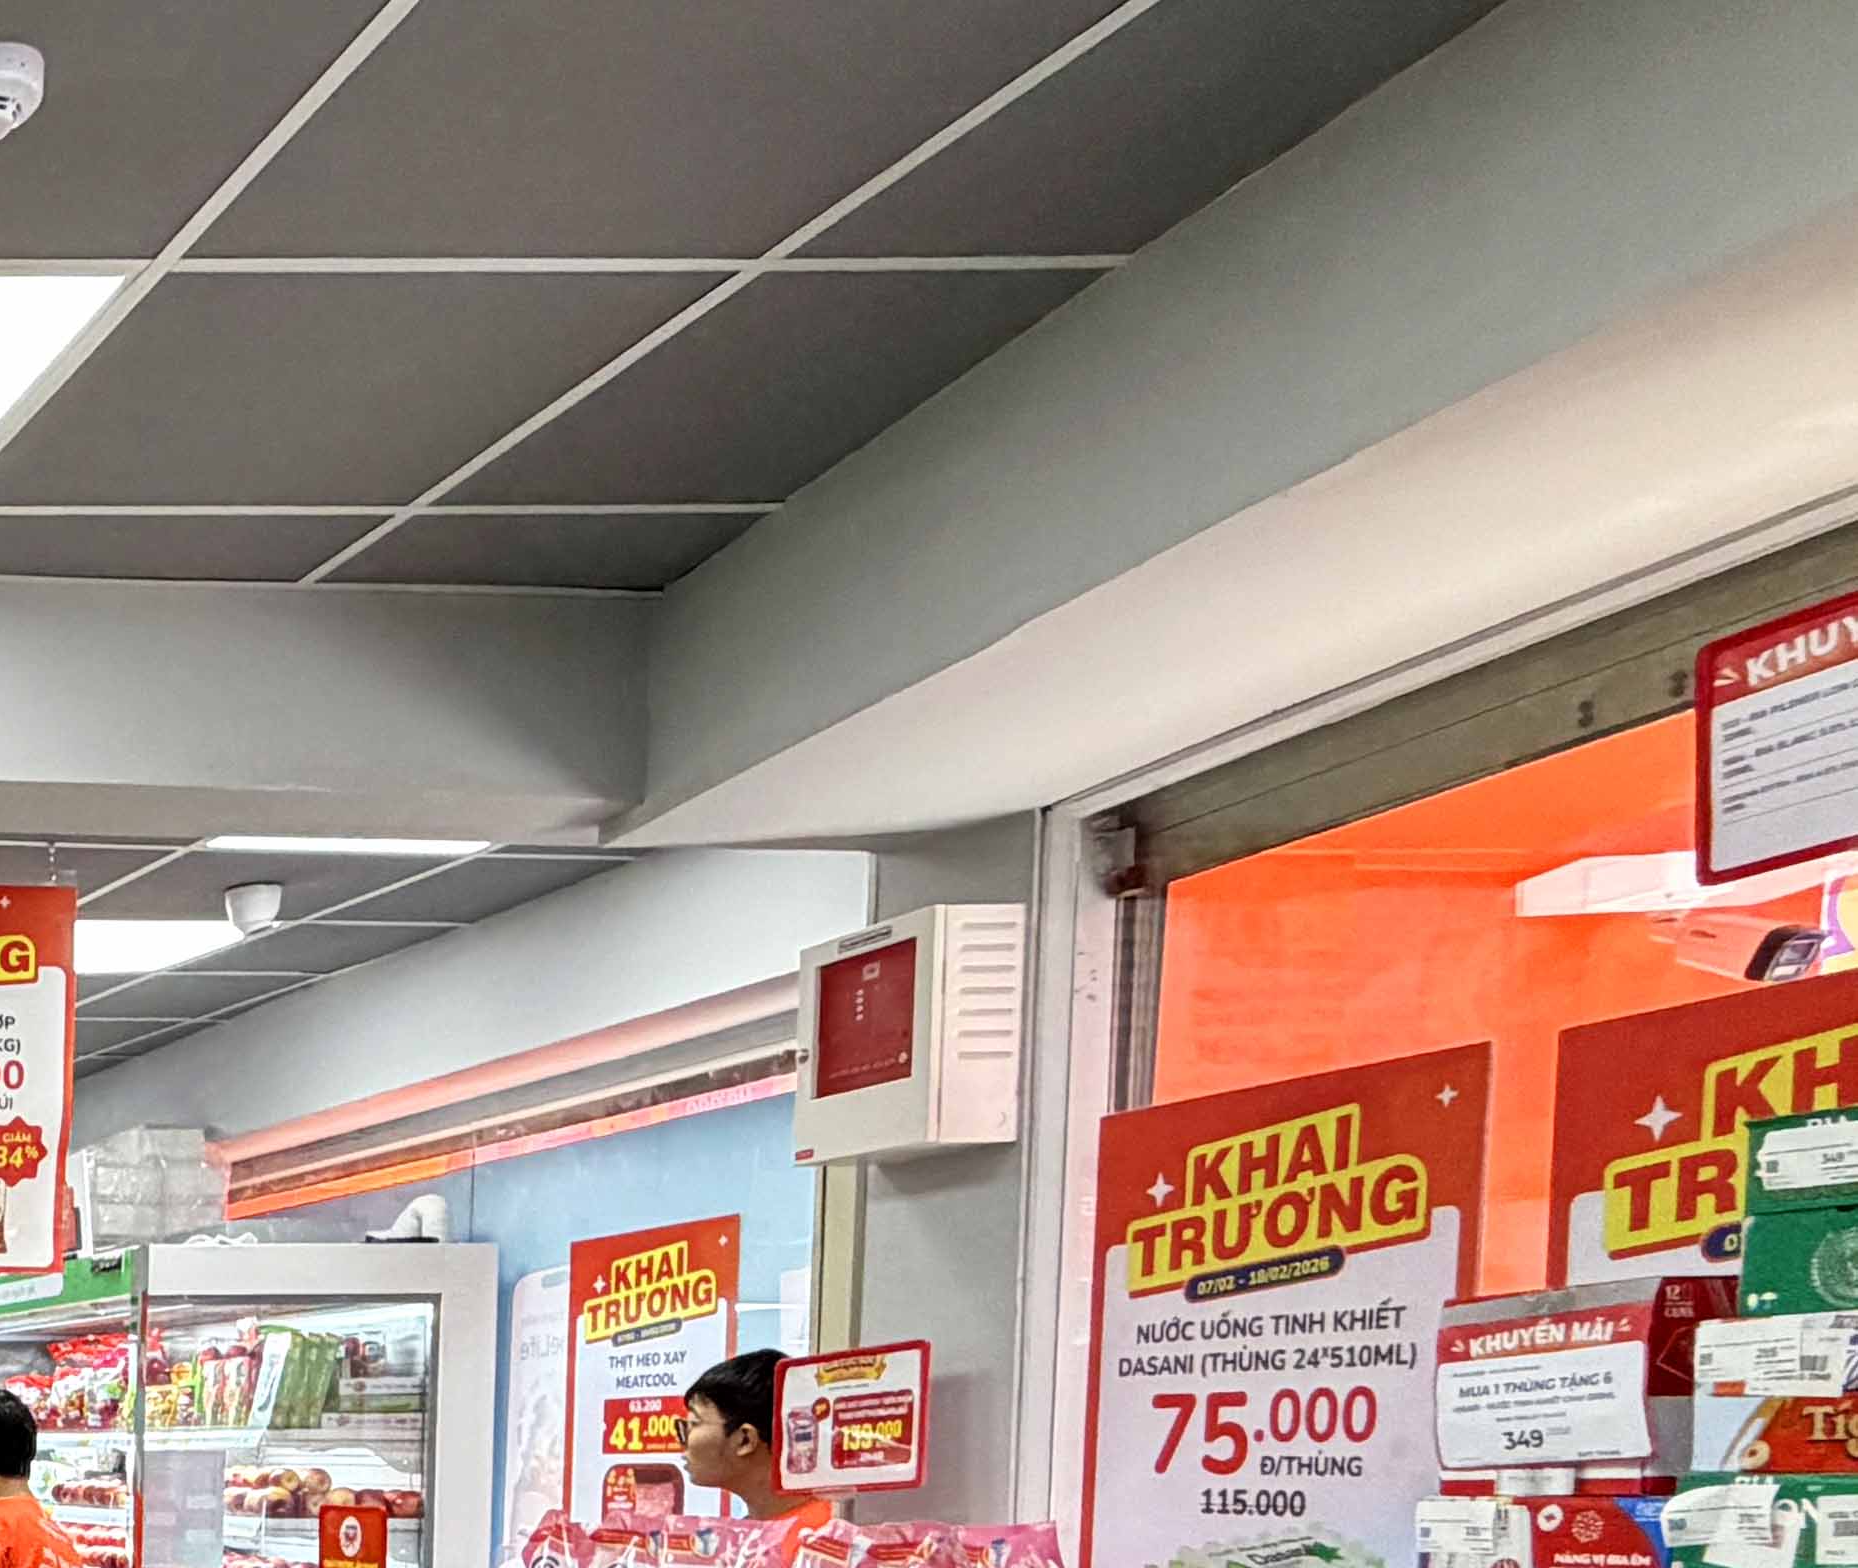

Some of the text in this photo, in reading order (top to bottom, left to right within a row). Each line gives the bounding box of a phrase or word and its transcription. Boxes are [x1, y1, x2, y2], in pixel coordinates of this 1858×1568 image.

[1190, 1113, 1357, 1206] KHAI
[1129, 1163, 1425, 1279] TRƯƠNG
[613, 1247, 685, 1294] KHAI
[587, 1276, 715, 1331] TRƯƠNG
[1136, 1297, 1407, 1344] NƯỚC UỐNG TINH KHIẾT
[1469, 1316, 1614, 1358] KHUYẾN MÃI
[609, 1350, 687, 1374] THỊT HEO XAY
[616, 1372, 677, 1390] MEATCOOL
[1458, 1371, 1613, 1399] MUA 1 THÙNG TẶNG 6
[1152, 1385, 1378, 1476] 75.000
[1502, 1429, 1544, 1450] 349
[1260, 1454, 1362, 1477] Đ/THÙNG
[1200, 1489, 1307, 1518] 115.000
